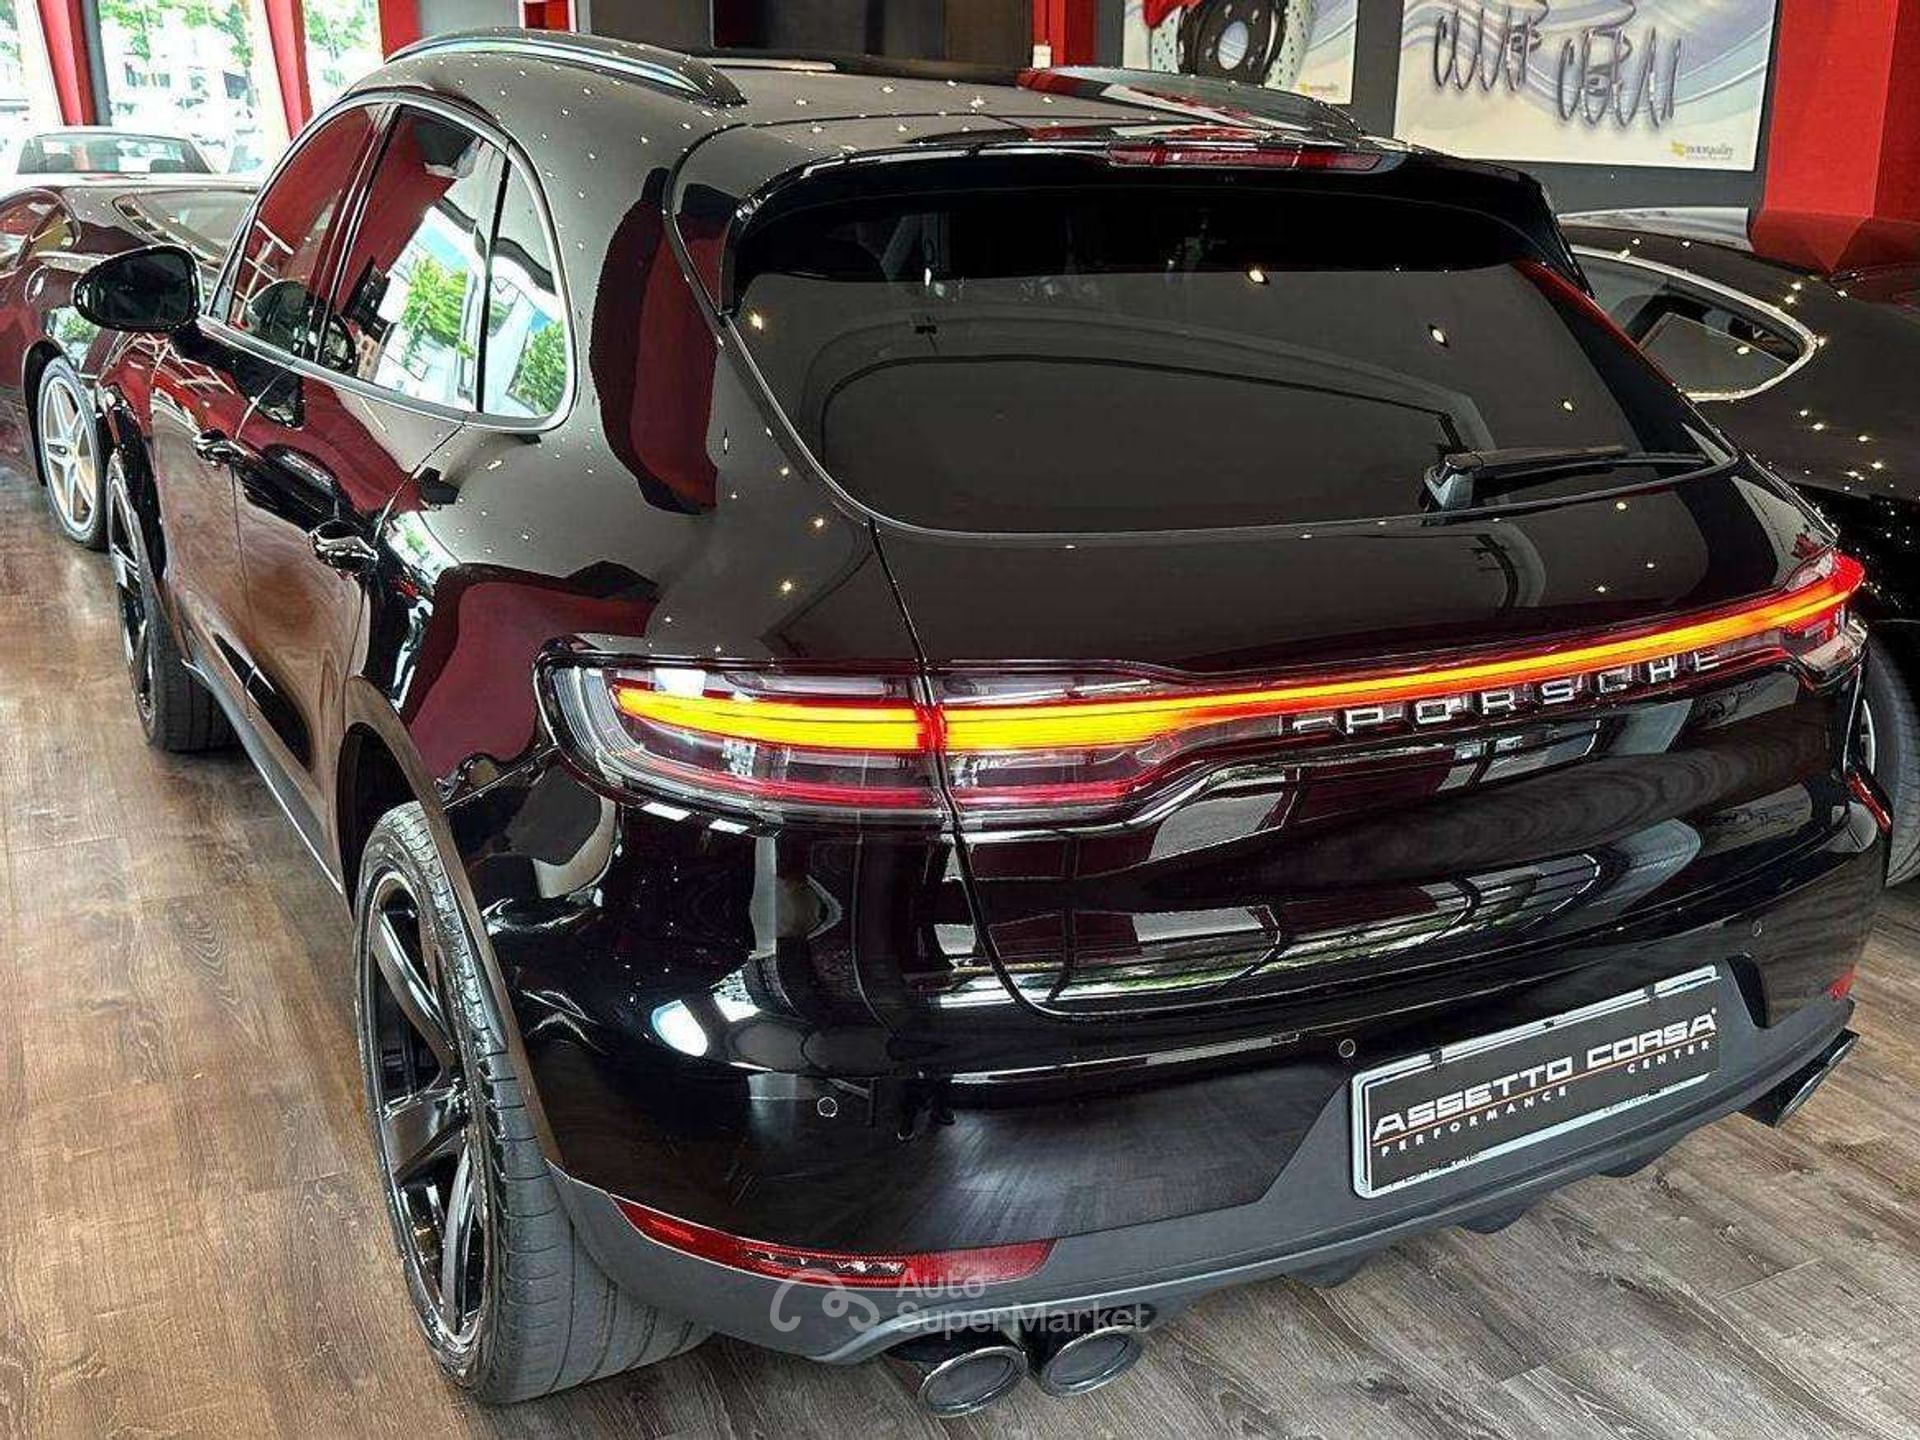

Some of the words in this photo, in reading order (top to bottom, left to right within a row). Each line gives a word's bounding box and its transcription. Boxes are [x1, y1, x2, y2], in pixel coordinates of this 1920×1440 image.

[1344, 650, 1720, 734] PORSCHE
[1373, 1056, 1573, 1141] ASSETTO
[1381, 1085, 1568, 1158] PERFORMANCE
[1627, 1039, 1710, 1074] CENTER
